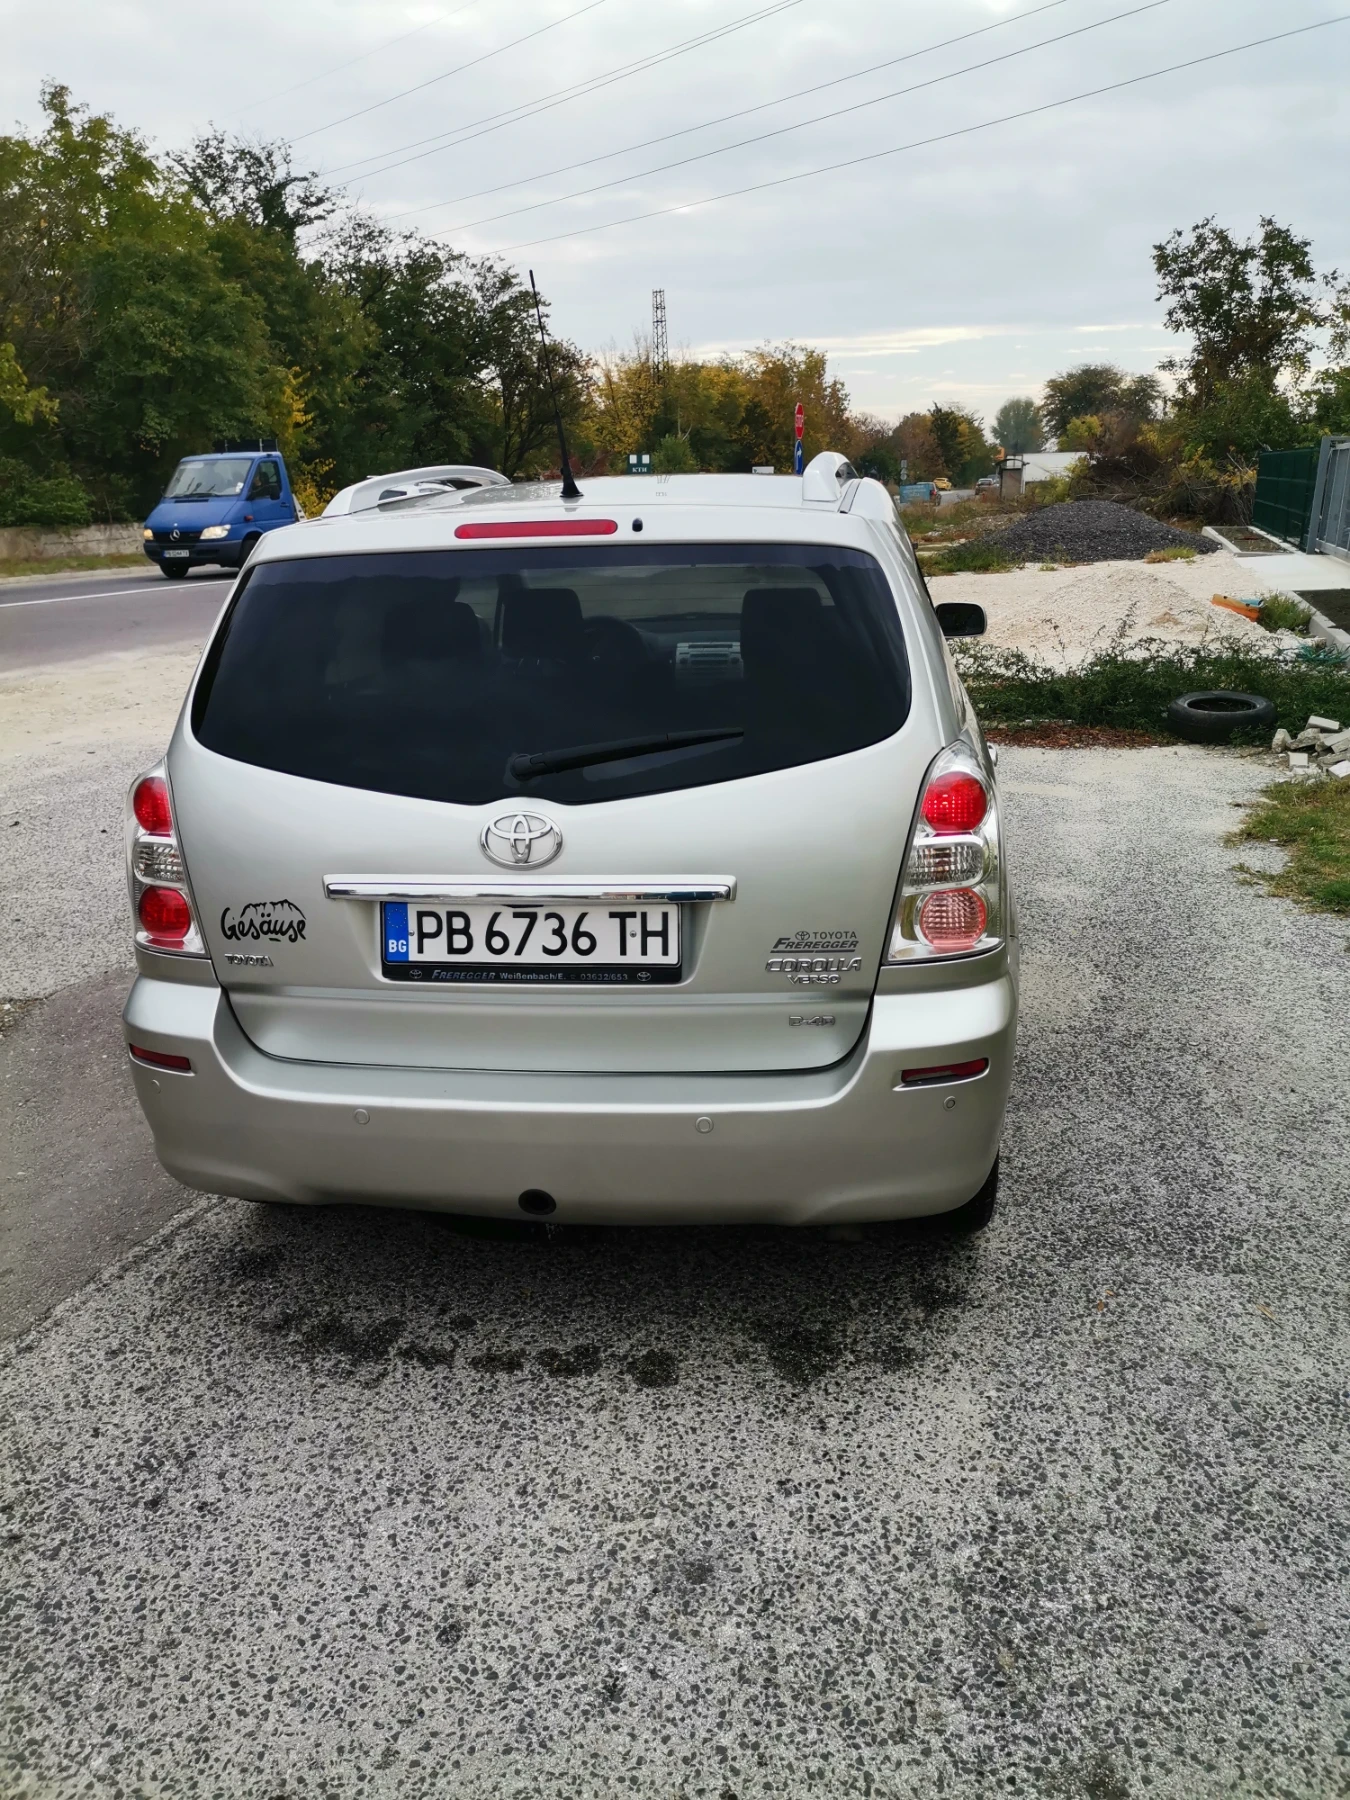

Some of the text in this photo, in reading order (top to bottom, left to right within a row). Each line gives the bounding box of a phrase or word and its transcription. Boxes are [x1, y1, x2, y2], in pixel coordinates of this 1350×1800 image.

[220, 906, 307, 943] Gesäuse
[416, 910, 669, 957] PB 6736 TH
[812, 931, 857, 940] TOYOTA
[388, 939, 407, 953] BG
[772, 937, 859, 949] FREREGGER
[224, 953, 274, 967] TOYOTA
[765, 957, 862, 973] COROLLA
[786, 974, 841, 985] VERSO
